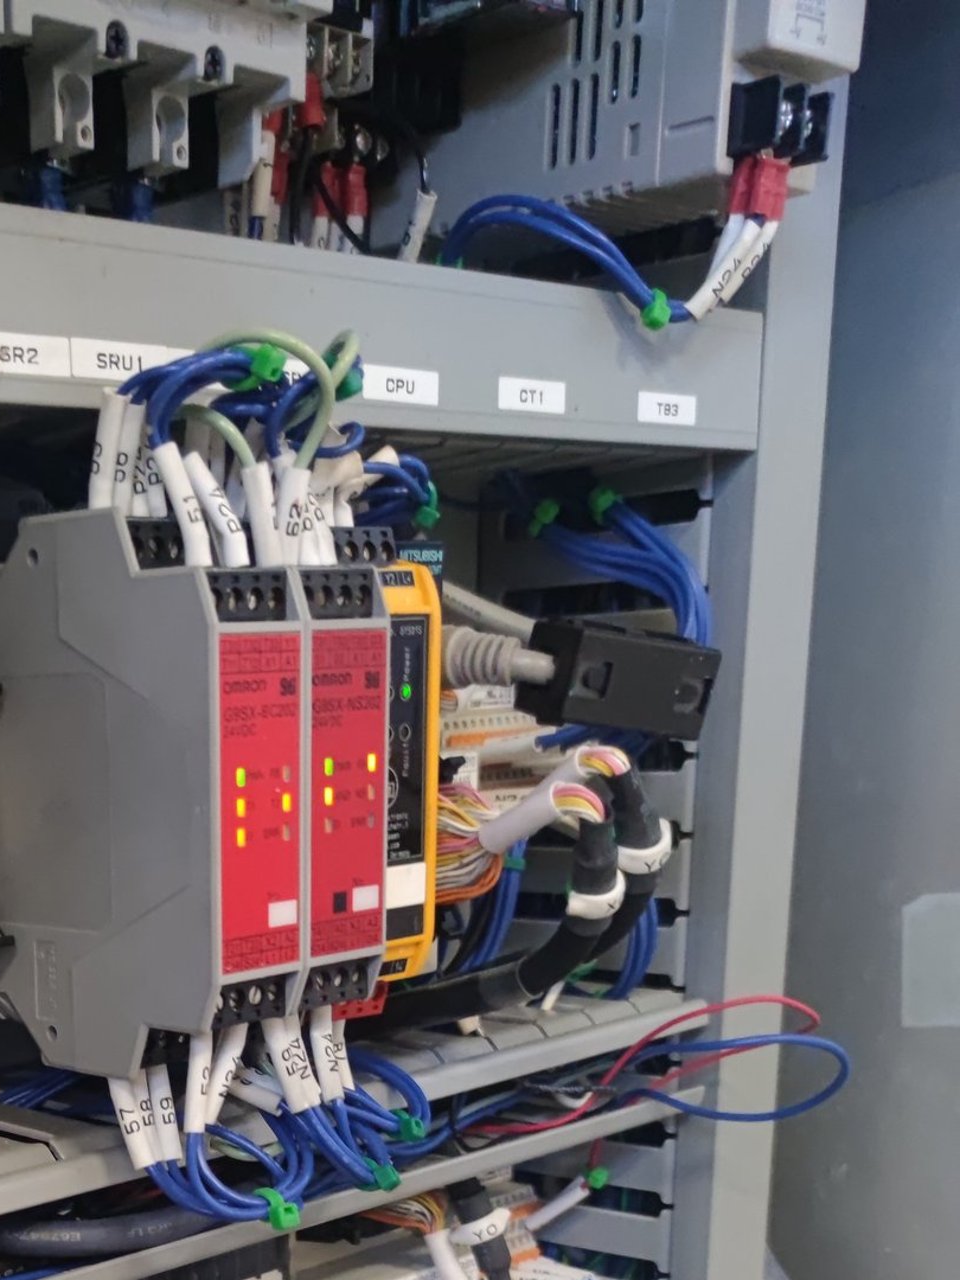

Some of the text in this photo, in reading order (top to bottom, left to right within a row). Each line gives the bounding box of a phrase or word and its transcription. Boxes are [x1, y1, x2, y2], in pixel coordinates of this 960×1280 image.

[385, 378, 415, 395] CPU
[519, 388, 543, 405] CT1
[119, 1108, 141, 1135] 57
[160, 1096, 176, 1125] 59
